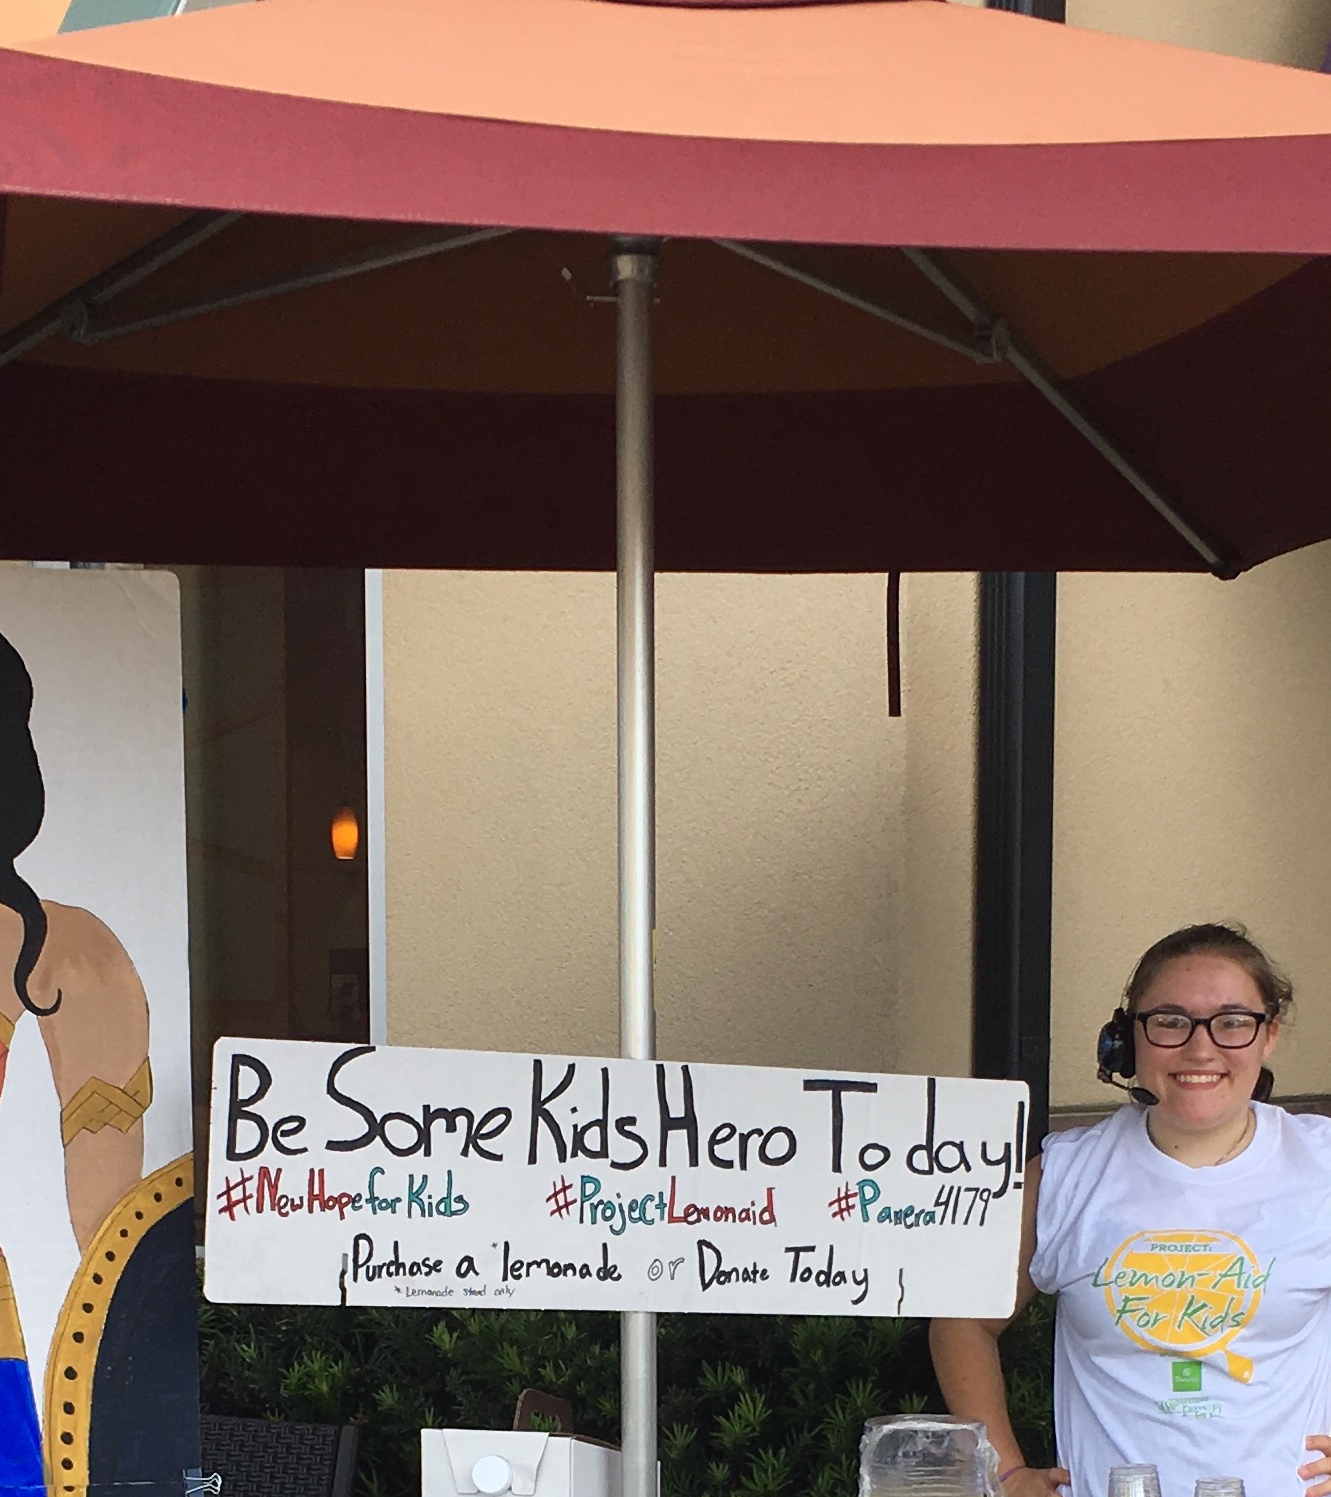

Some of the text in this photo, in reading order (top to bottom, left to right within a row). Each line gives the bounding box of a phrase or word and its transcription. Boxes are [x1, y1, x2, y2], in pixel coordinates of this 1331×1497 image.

[226, 1046, 1027, 1200] Be Some Kids Hero Today!
[828, 1178, 994, 1230] #Panera4179
[352, 1233, 443, 1283] Purchase
[456, 1255, 478, 1279] a
[646, 1256, 685, 1281] or
[696, 1239, 770, 1292] Donate
[783, 1244, 869, 1306] Today
[1150, 1243, 1213, 1253] PROJECT:
[1090, 1256, 1276, 1295] Lemon-Aid
[1114, 1294, 1246, 1337] For Kids
